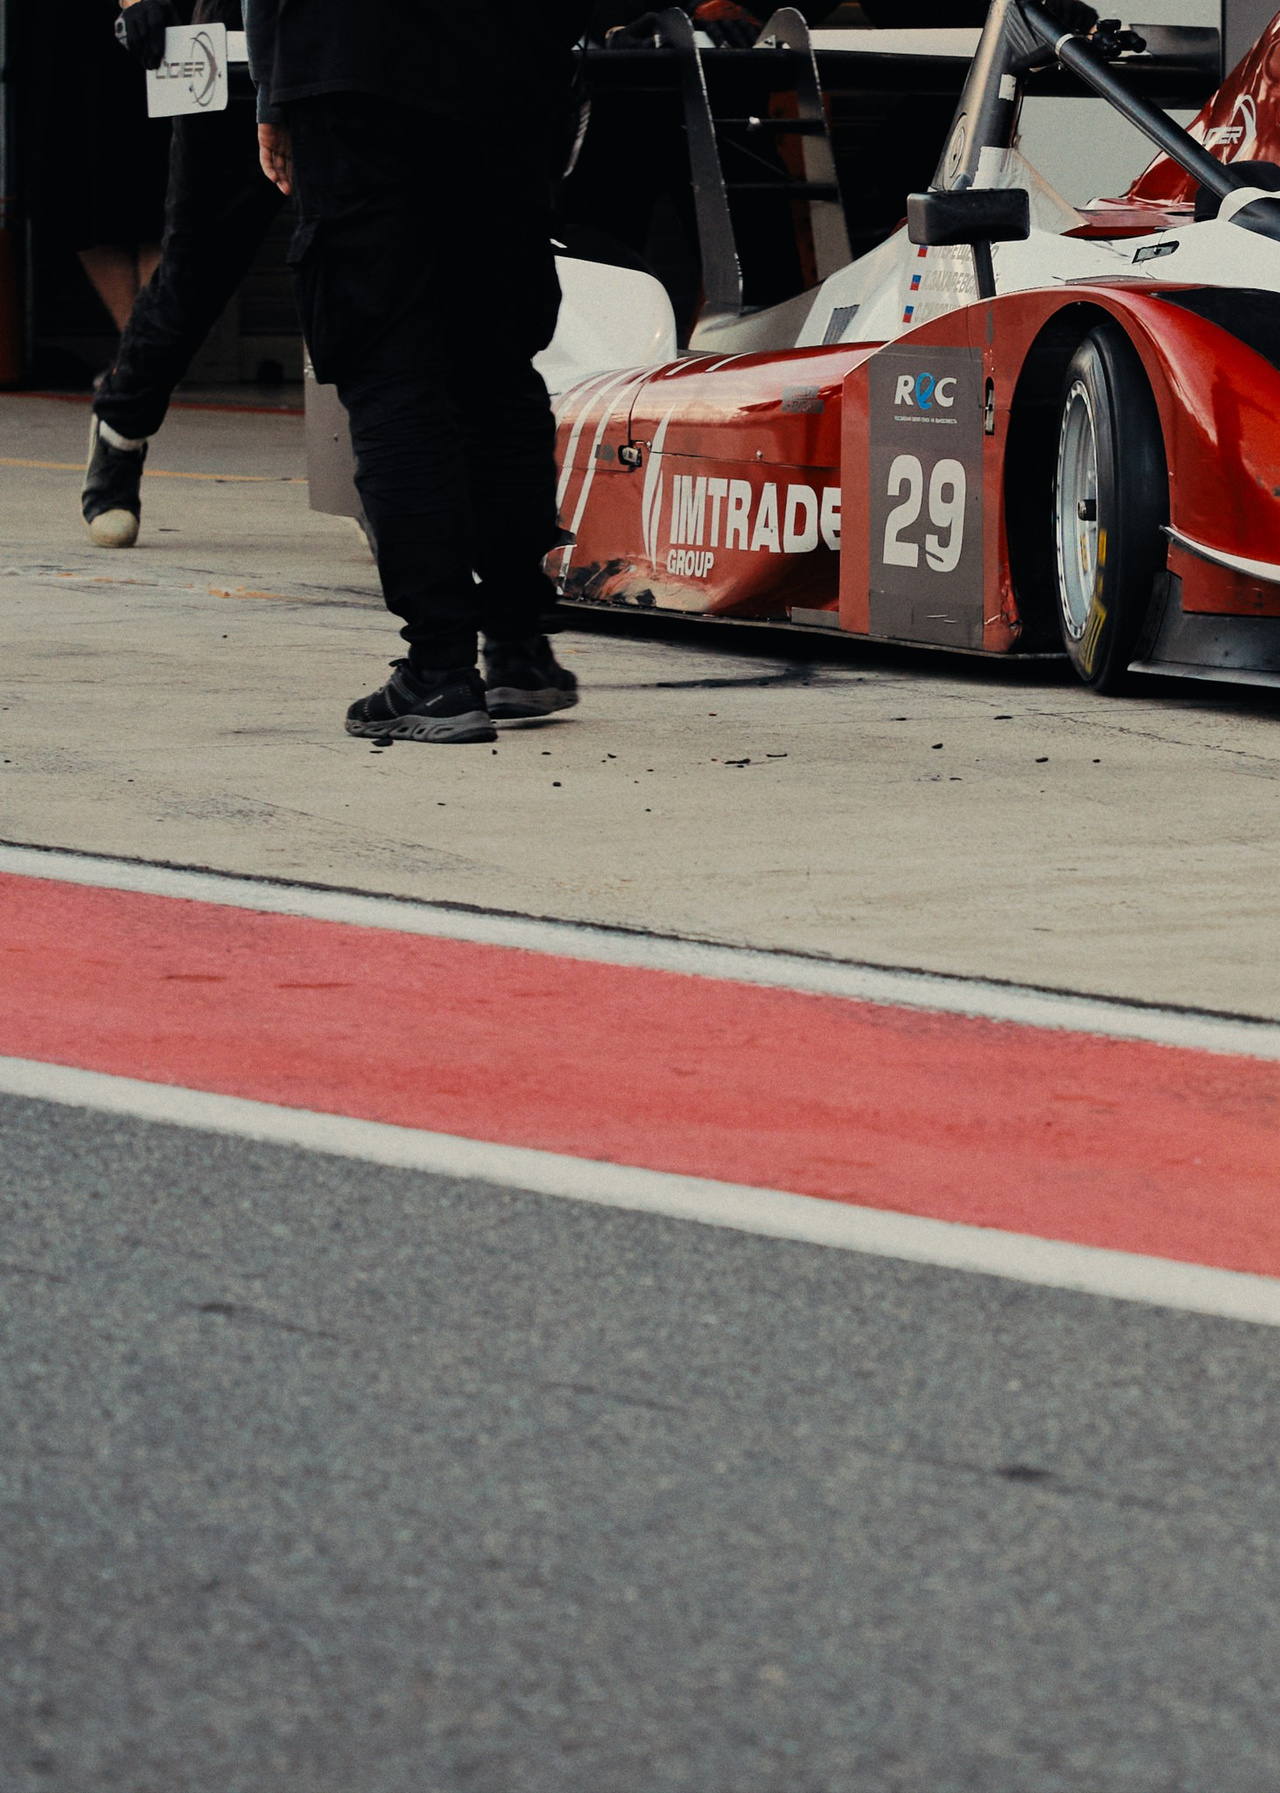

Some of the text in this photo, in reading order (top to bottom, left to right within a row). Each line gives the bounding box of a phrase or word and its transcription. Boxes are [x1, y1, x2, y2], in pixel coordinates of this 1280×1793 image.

[669, 474, 842, 553] IMTRADE
[882, 454, 967, 572] 29
[666, 548, 714, 578] GROUP
